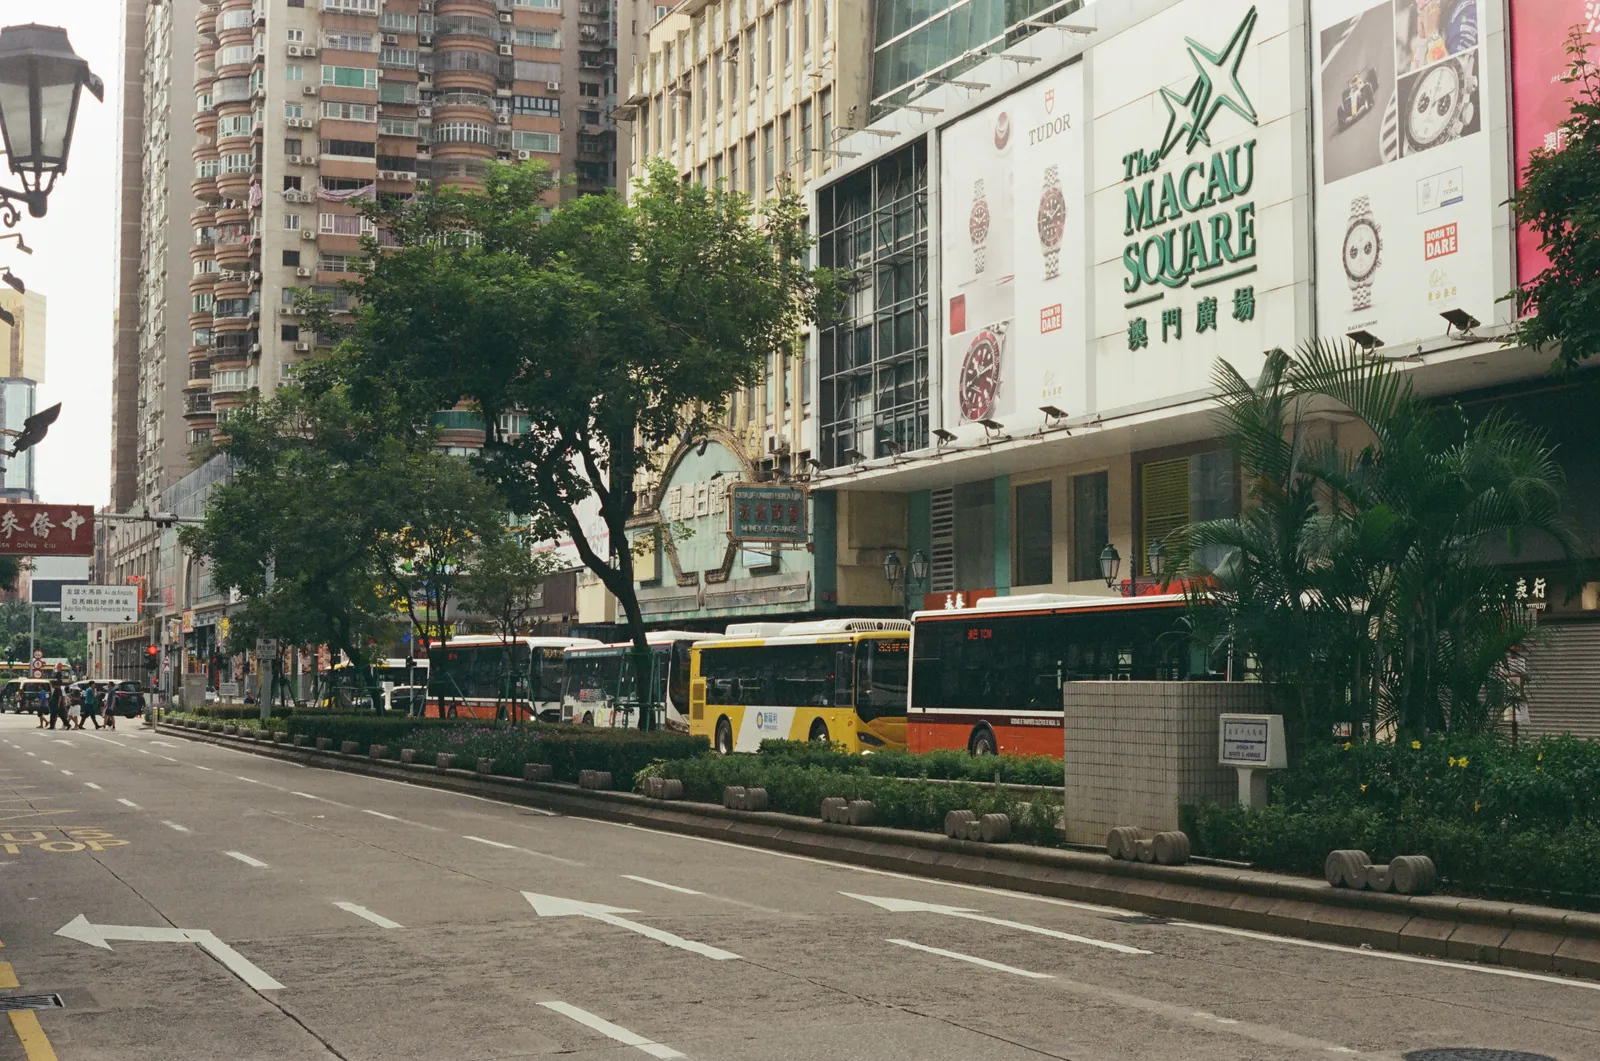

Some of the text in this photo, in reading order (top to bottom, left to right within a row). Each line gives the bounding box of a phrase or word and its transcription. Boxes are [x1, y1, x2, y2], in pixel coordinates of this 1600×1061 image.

[1029, 113, 1071, 146] TUDOR
[1122, 148, 1160, 181] The
[1123, 138, 1257, 236] MACAU
[1123, 201, 1256, 293] SQUARE
[1427, 225, 1456, 242] BORN TO
[1427, 236, 1456, 258] DARE
[1042, 315, 1061, 331] DARE
[1127, 285, 1256, 351] 澳門廣場
[741, 525, 798, 534] MONEY EXCHANGE
[1515, 577, 1546, 599] 表行
